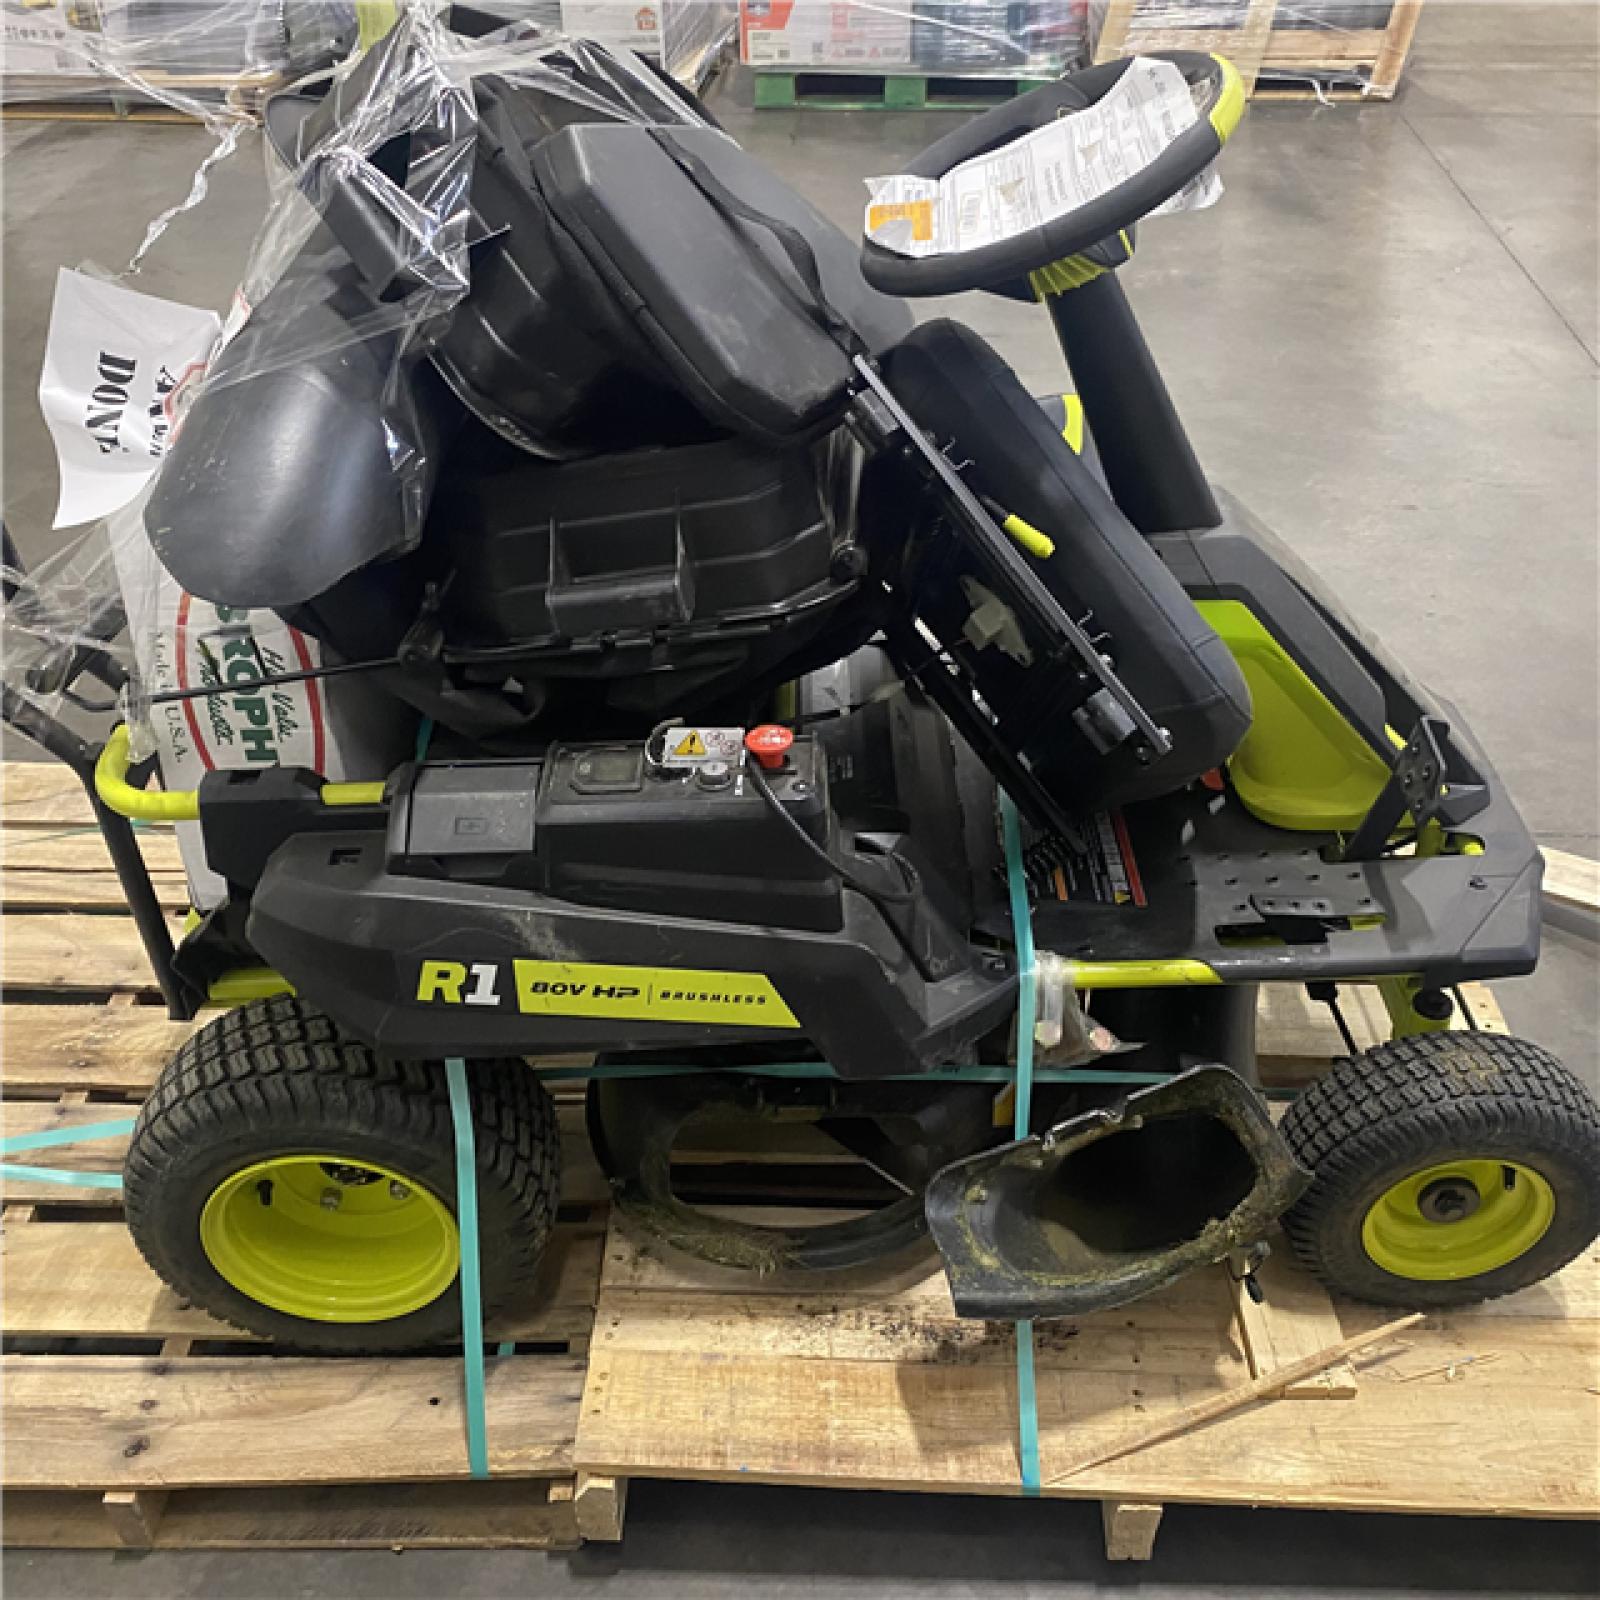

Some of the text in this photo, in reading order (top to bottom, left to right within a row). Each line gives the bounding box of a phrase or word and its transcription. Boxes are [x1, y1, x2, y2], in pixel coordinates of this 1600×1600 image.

[417, 959, 766, 1006] R1 80V HP BRUSHLESS
